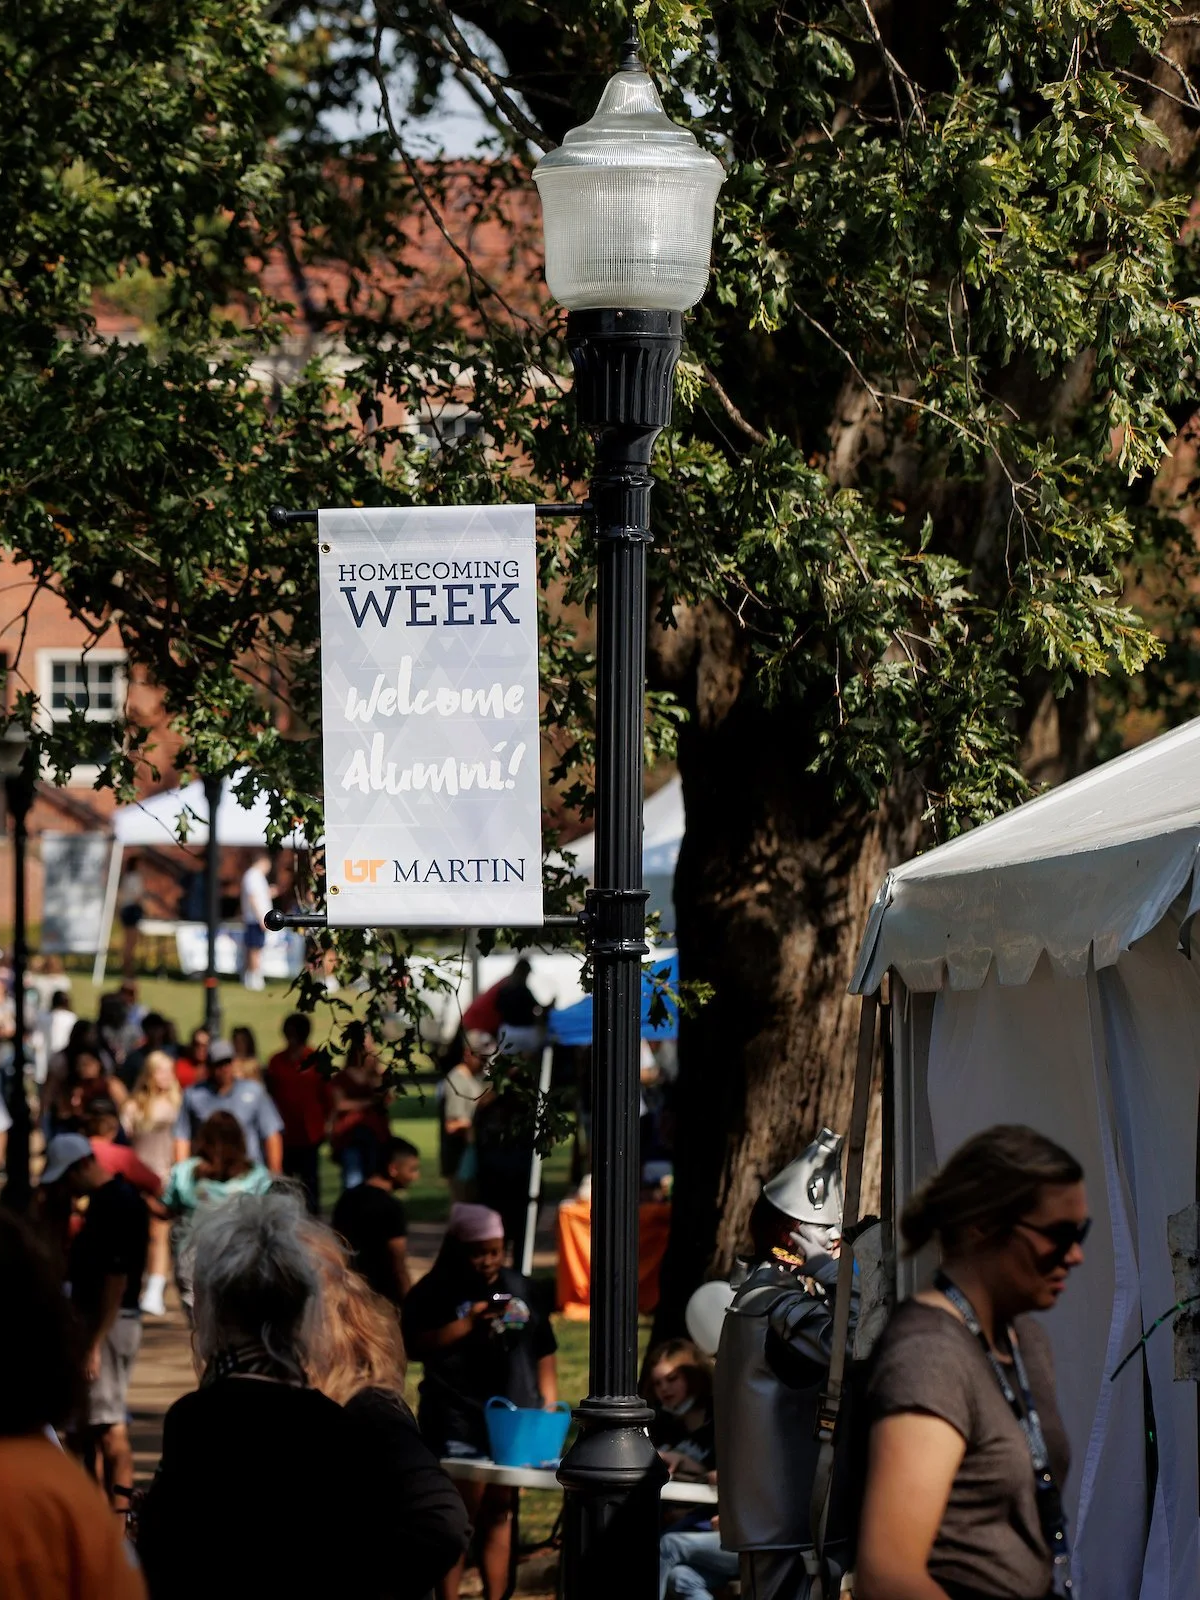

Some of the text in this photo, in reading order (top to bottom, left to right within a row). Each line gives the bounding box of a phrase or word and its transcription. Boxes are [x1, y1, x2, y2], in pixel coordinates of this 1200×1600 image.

[338, 560, 520, 582] HOMECOMING
[339, 583, 521, 629] WEEK
[344, 655, 525, 723] Welcome
[341, 731, 526, 796] Alumni!
[344, 858, 526, 883] UT MARTIN
